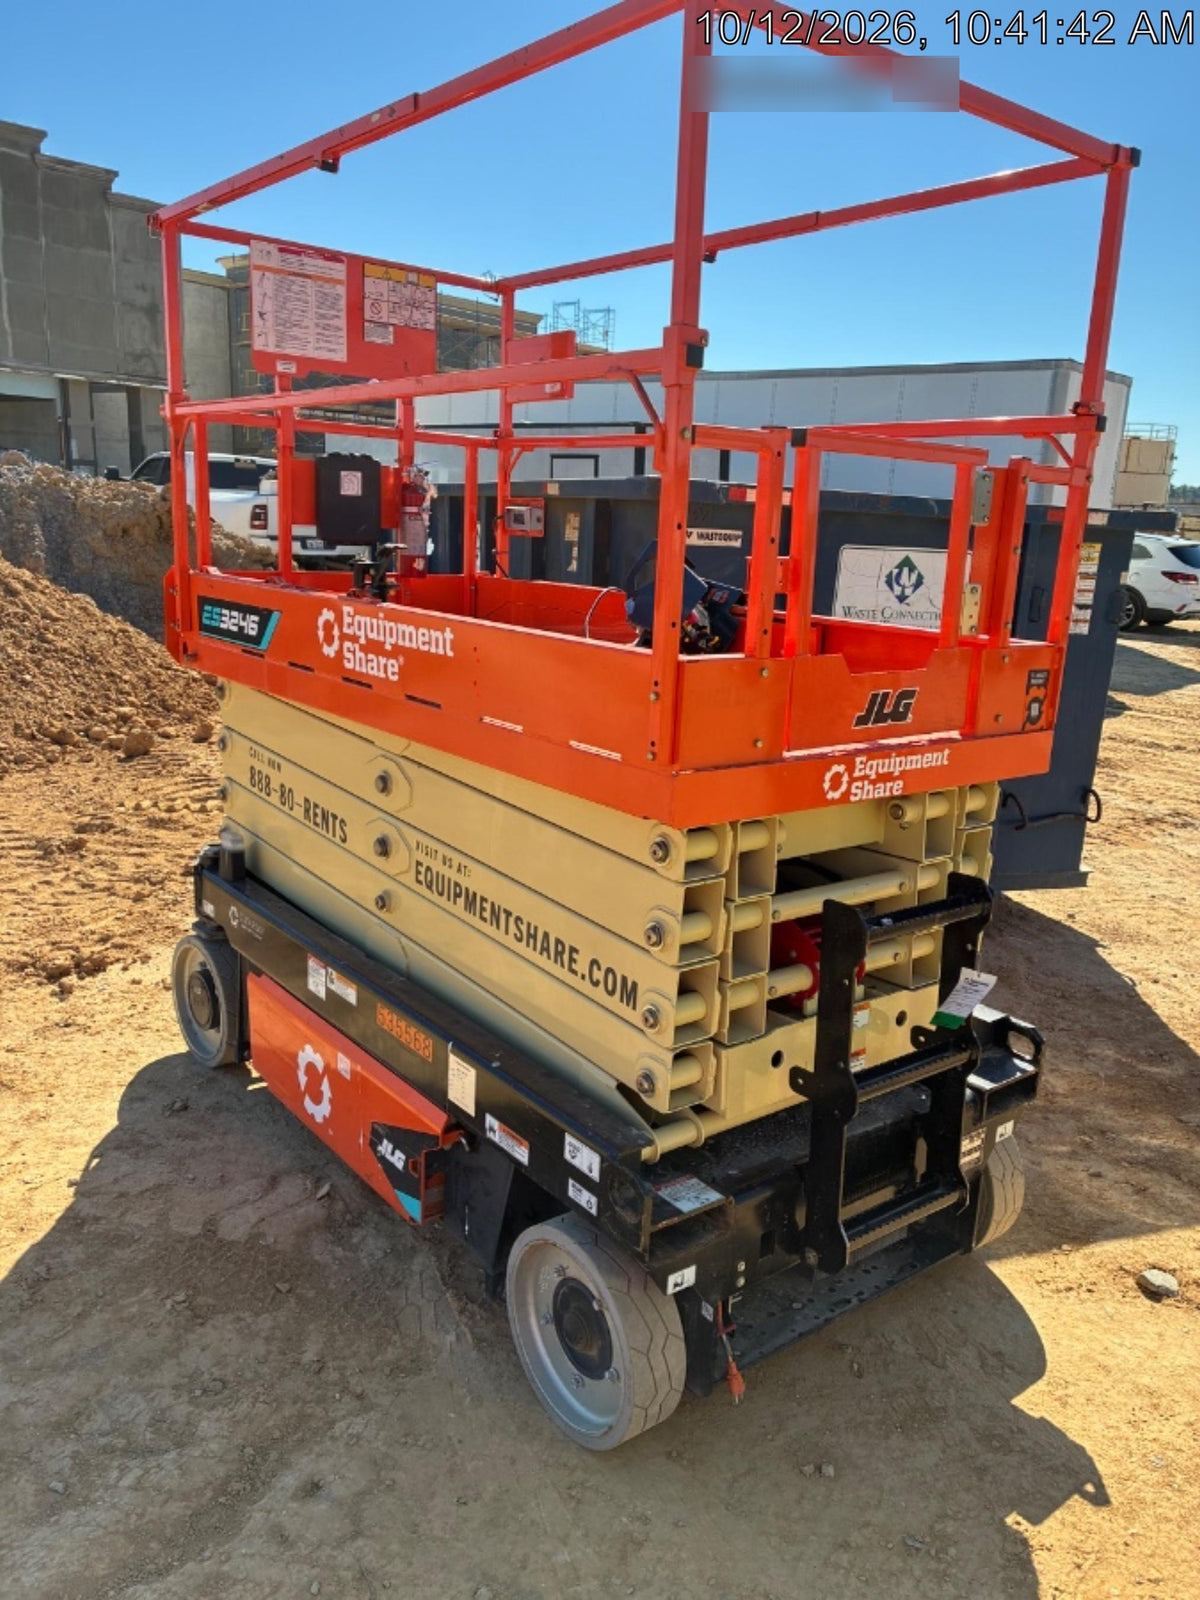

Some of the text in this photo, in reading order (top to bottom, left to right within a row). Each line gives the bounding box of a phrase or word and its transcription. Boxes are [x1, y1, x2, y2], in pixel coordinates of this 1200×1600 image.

[341, 605, 455, 657] Equipment
[342, 641, 400, 682] Share
[852, 687, 920, 730] JLG
[853, 748, 951, 780] Equipment
[249, 765, 348, 844] 888-80-RENTS
[850, 779, 904, 802] Share
[415, 840, 472, 878] VISIT US AT:
[414, 859, 639, 1012] EQUIPMENTSHARE.COM
[377, 1138, 406, 1171] JLG
